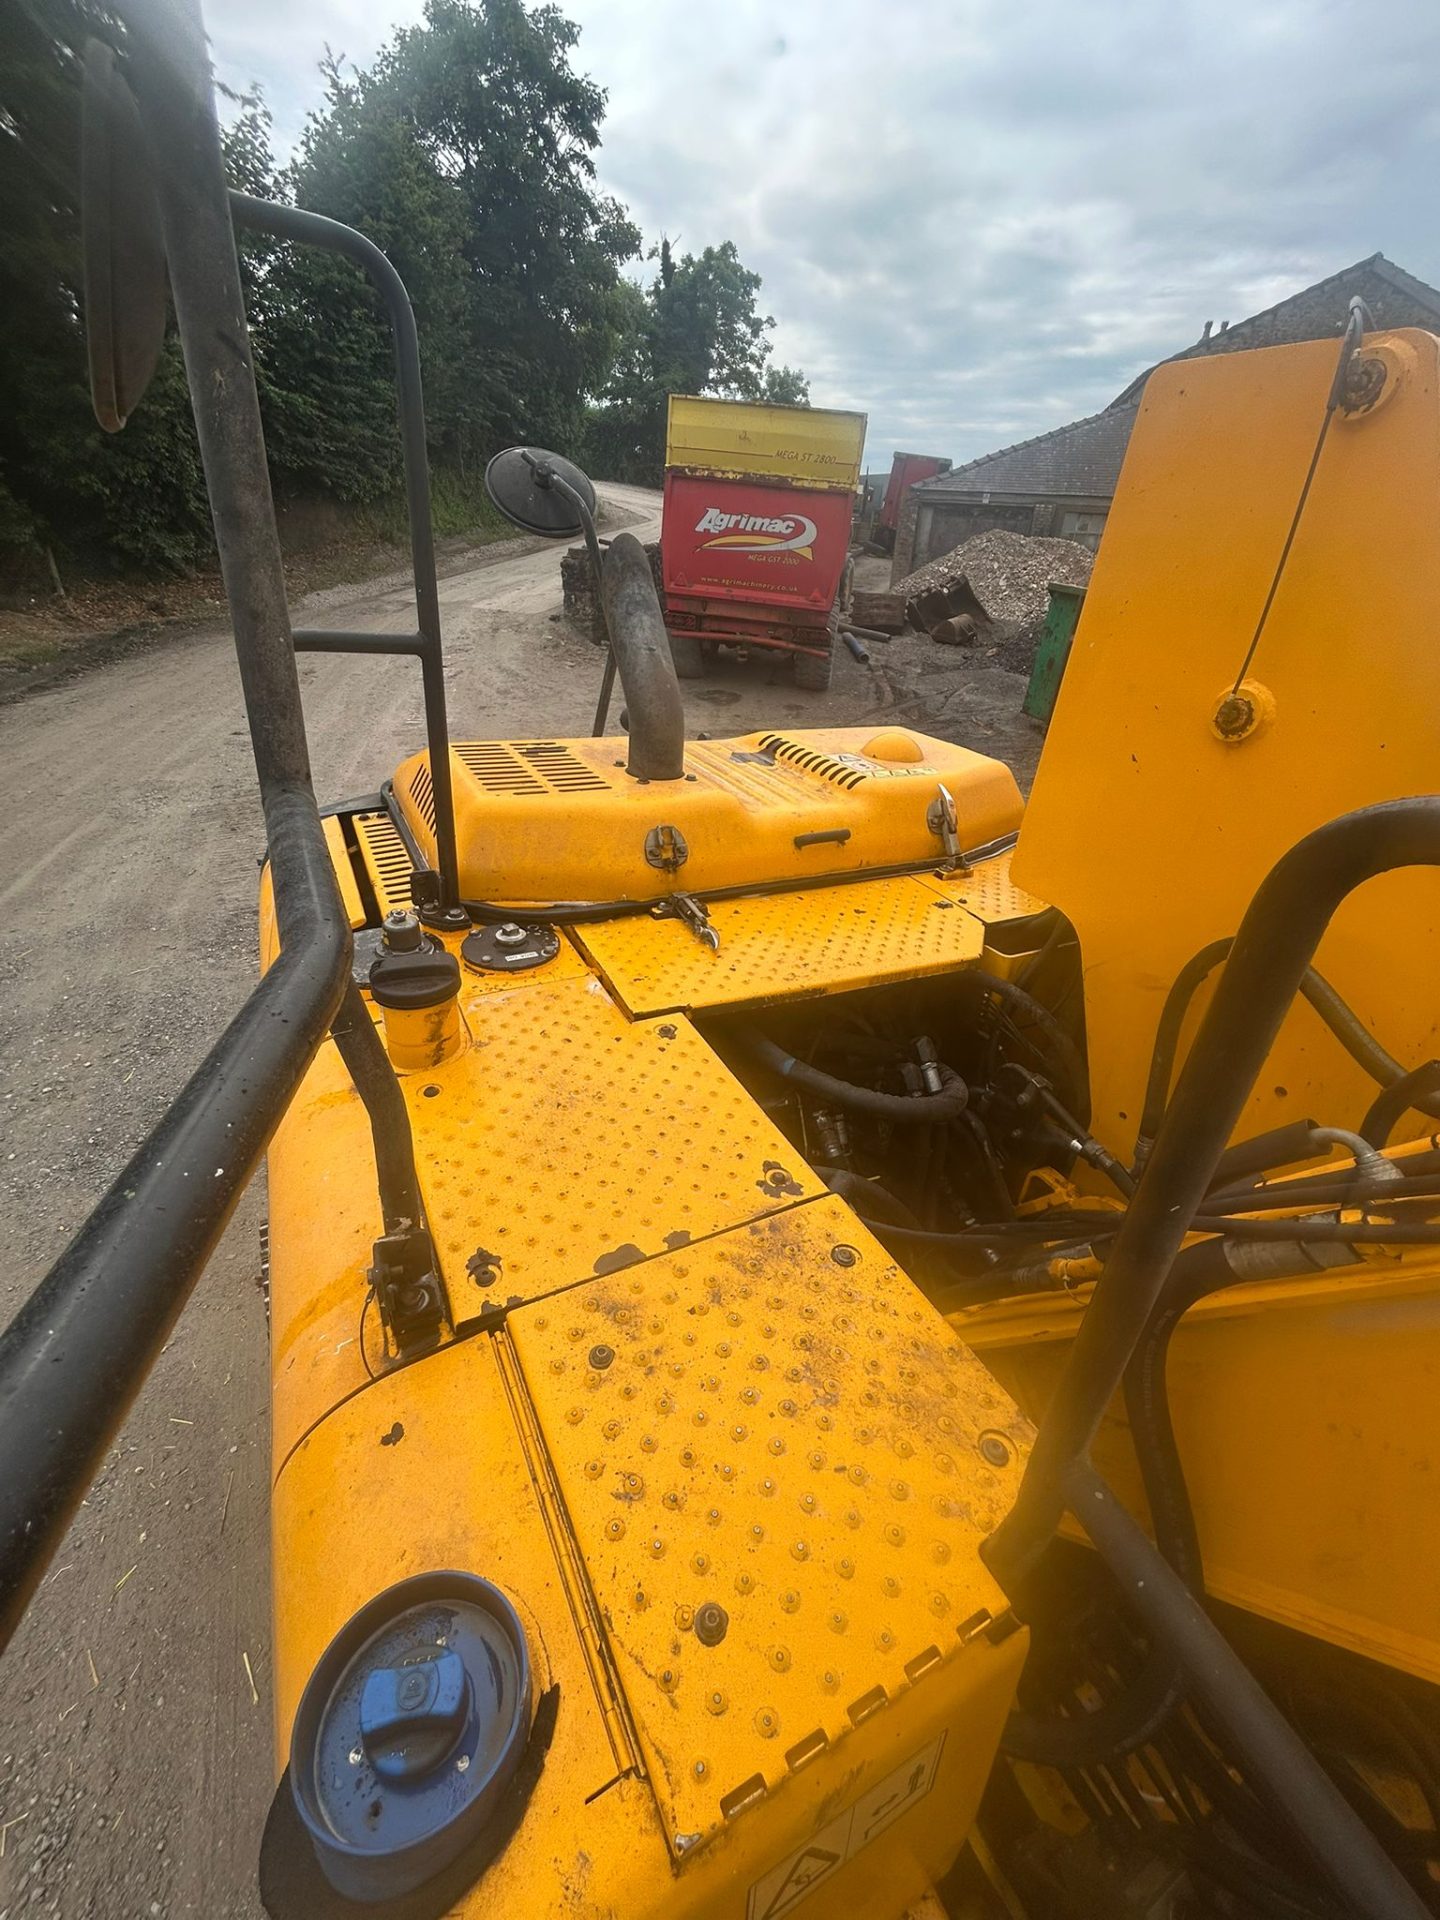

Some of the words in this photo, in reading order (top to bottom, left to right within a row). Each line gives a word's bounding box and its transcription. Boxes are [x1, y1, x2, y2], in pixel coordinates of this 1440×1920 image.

[774, 450, 798, 460] MEGA
[801, 453, 813, 462] ST
[814, 454, 836, 465] 2800
[695, 507, 796, 534] Agrimac
[748, 553, 766, 562] MEGA
